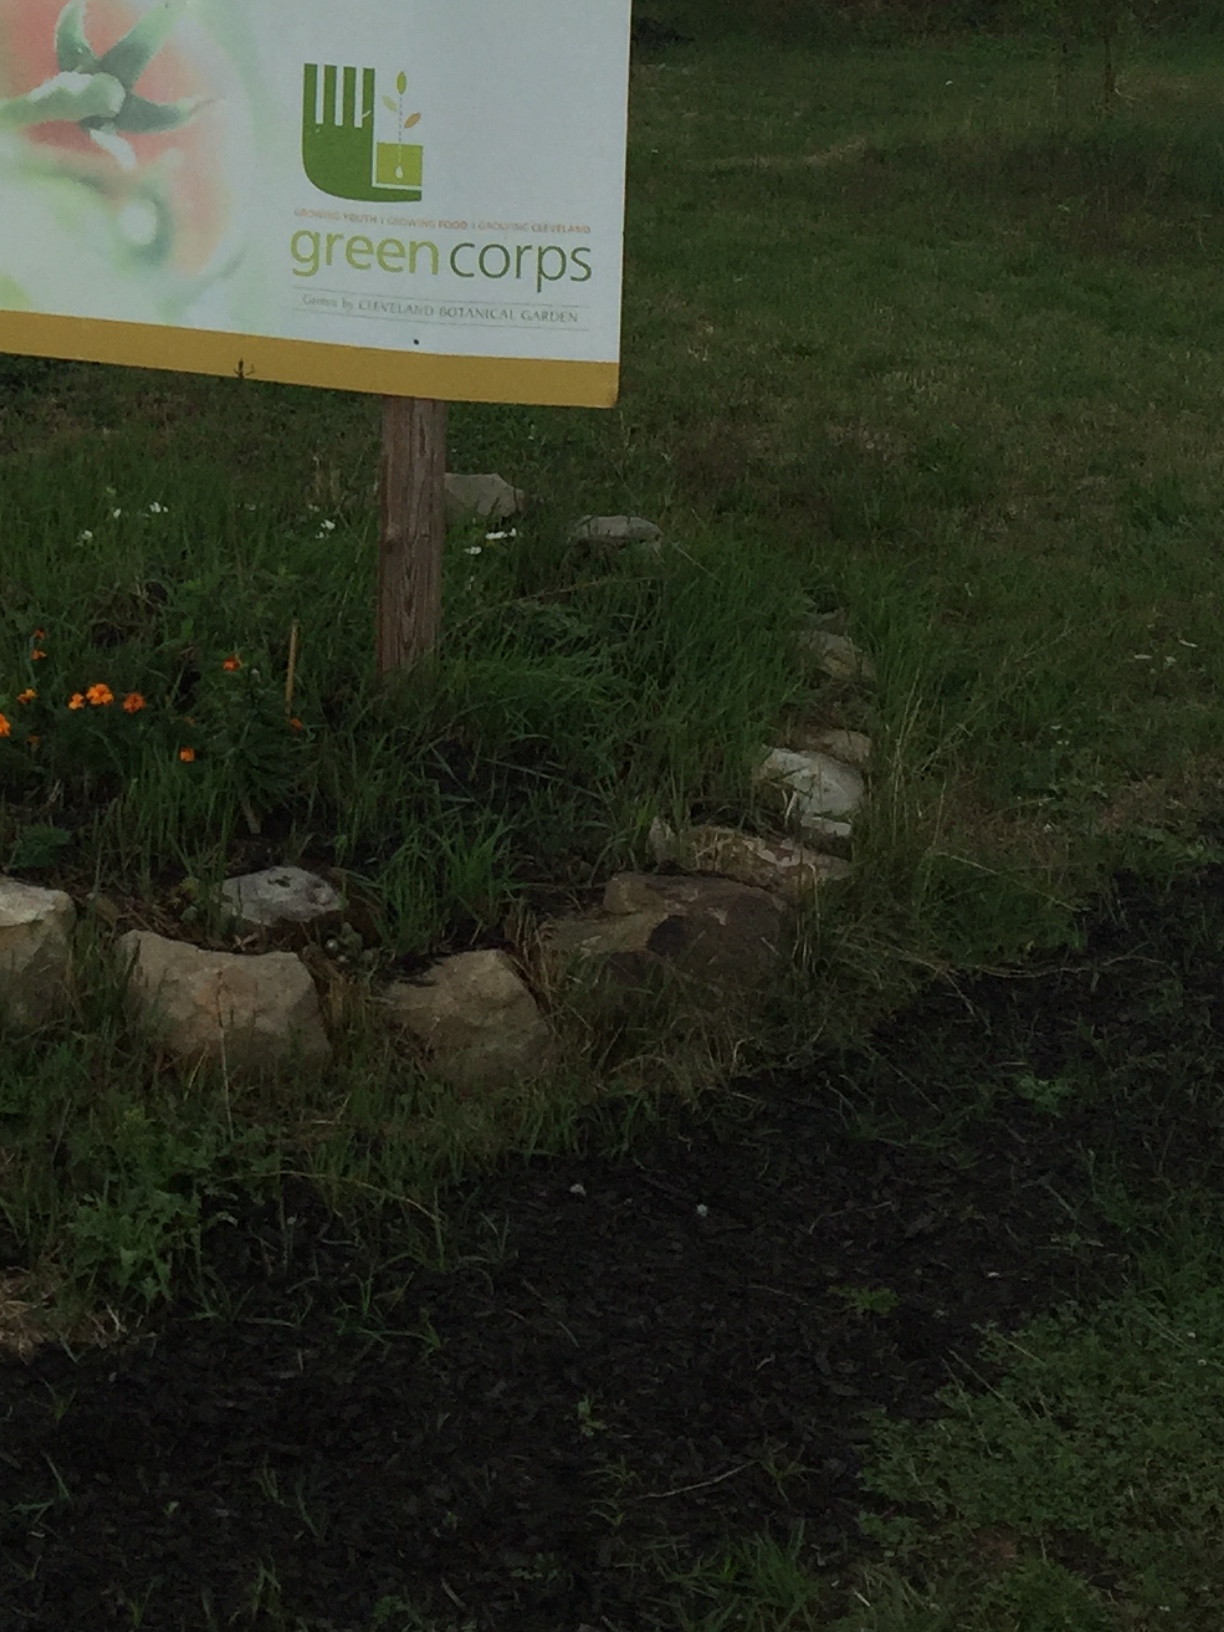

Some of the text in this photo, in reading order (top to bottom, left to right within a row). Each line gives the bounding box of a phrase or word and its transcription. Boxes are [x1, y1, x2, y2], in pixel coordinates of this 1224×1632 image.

[343, 212, 377, 224] YOUTH
[386, 215, 436, 229] GROWING
[438, 219, 468, 231] FOOD
[531, 222, 591, 234] CLEVELAND
[290, 229, 592, 294] green corps
[342, 297, 354, 312] by
[358, 299, 435, 317] CLEVELAND
[438, 305, 515, 321] BOTANICAL
[520, 309, 579, 324] GARDEN
